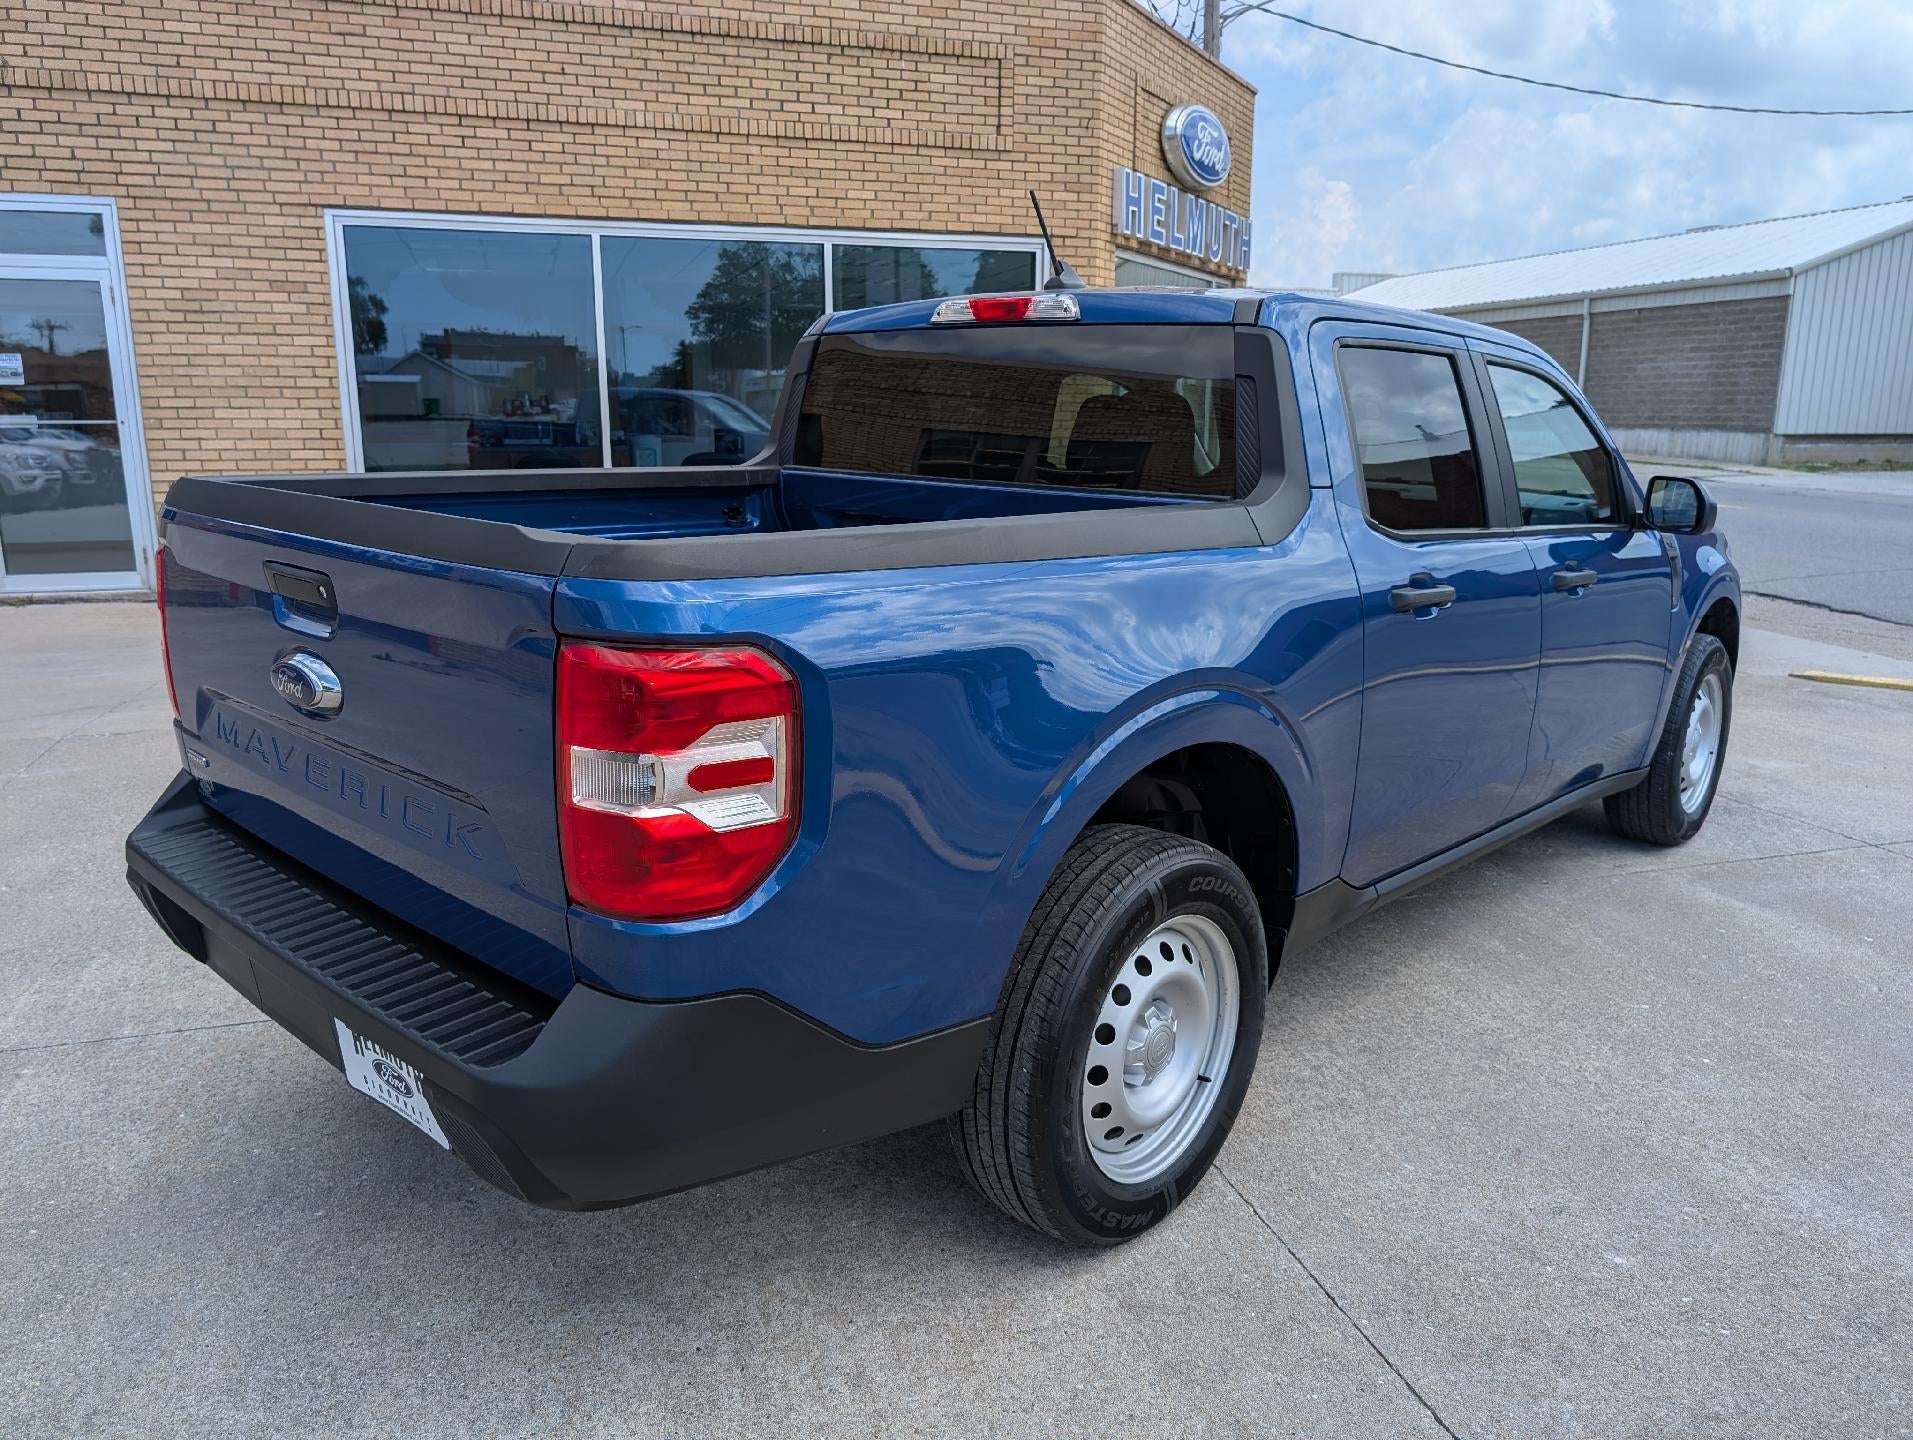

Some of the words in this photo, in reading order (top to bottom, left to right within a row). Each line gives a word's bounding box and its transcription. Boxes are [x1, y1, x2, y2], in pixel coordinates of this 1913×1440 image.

[1193, 121, 1226, 172] Ford
[1122, 167, 1252, 272] HELMUTH
[277, 667, 304, 699] Ford
[216, 710, 483, 860] MAVERICK
[380, 1063, 407, 1094] Ford
